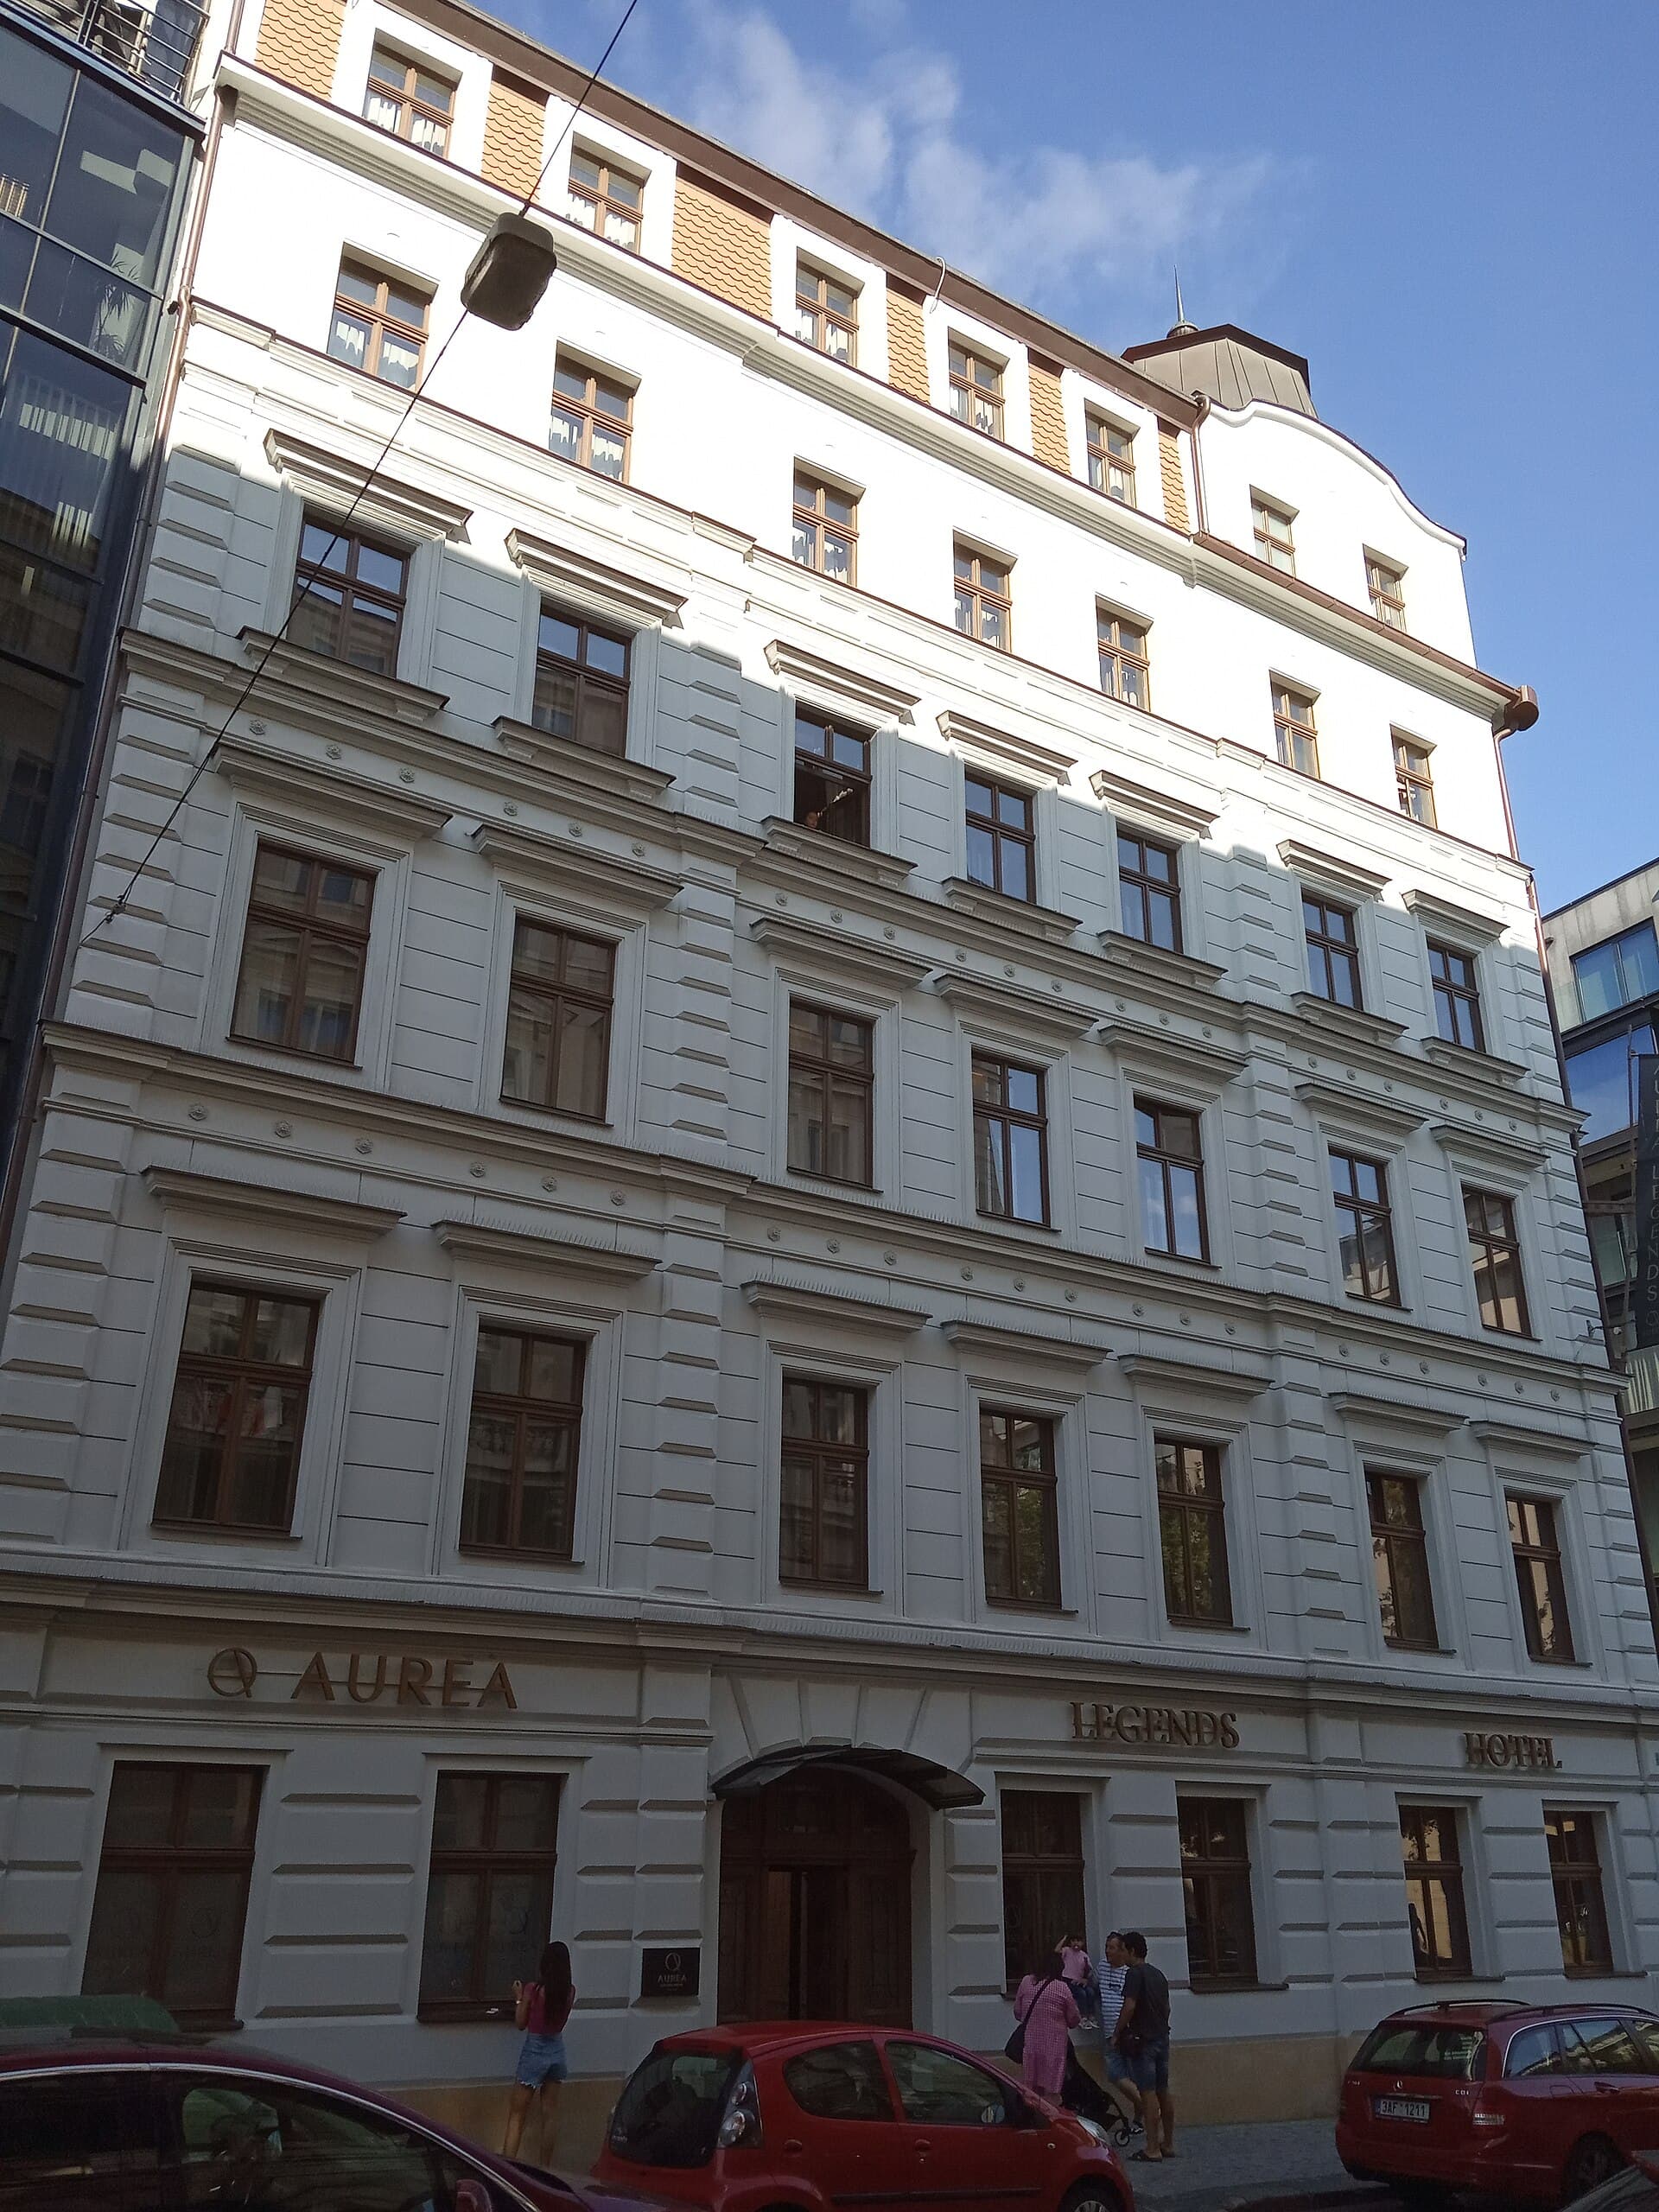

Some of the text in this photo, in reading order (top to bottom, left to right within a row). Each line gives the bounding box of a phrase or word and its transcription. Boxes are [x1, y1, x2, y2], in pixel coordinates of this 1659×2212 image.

[290, 1651, 518, 1709] AUREA
[1070, 1701, 1240, 1748] LEGENDS
[1463, 1732, 1562, 1769] HOTEL
